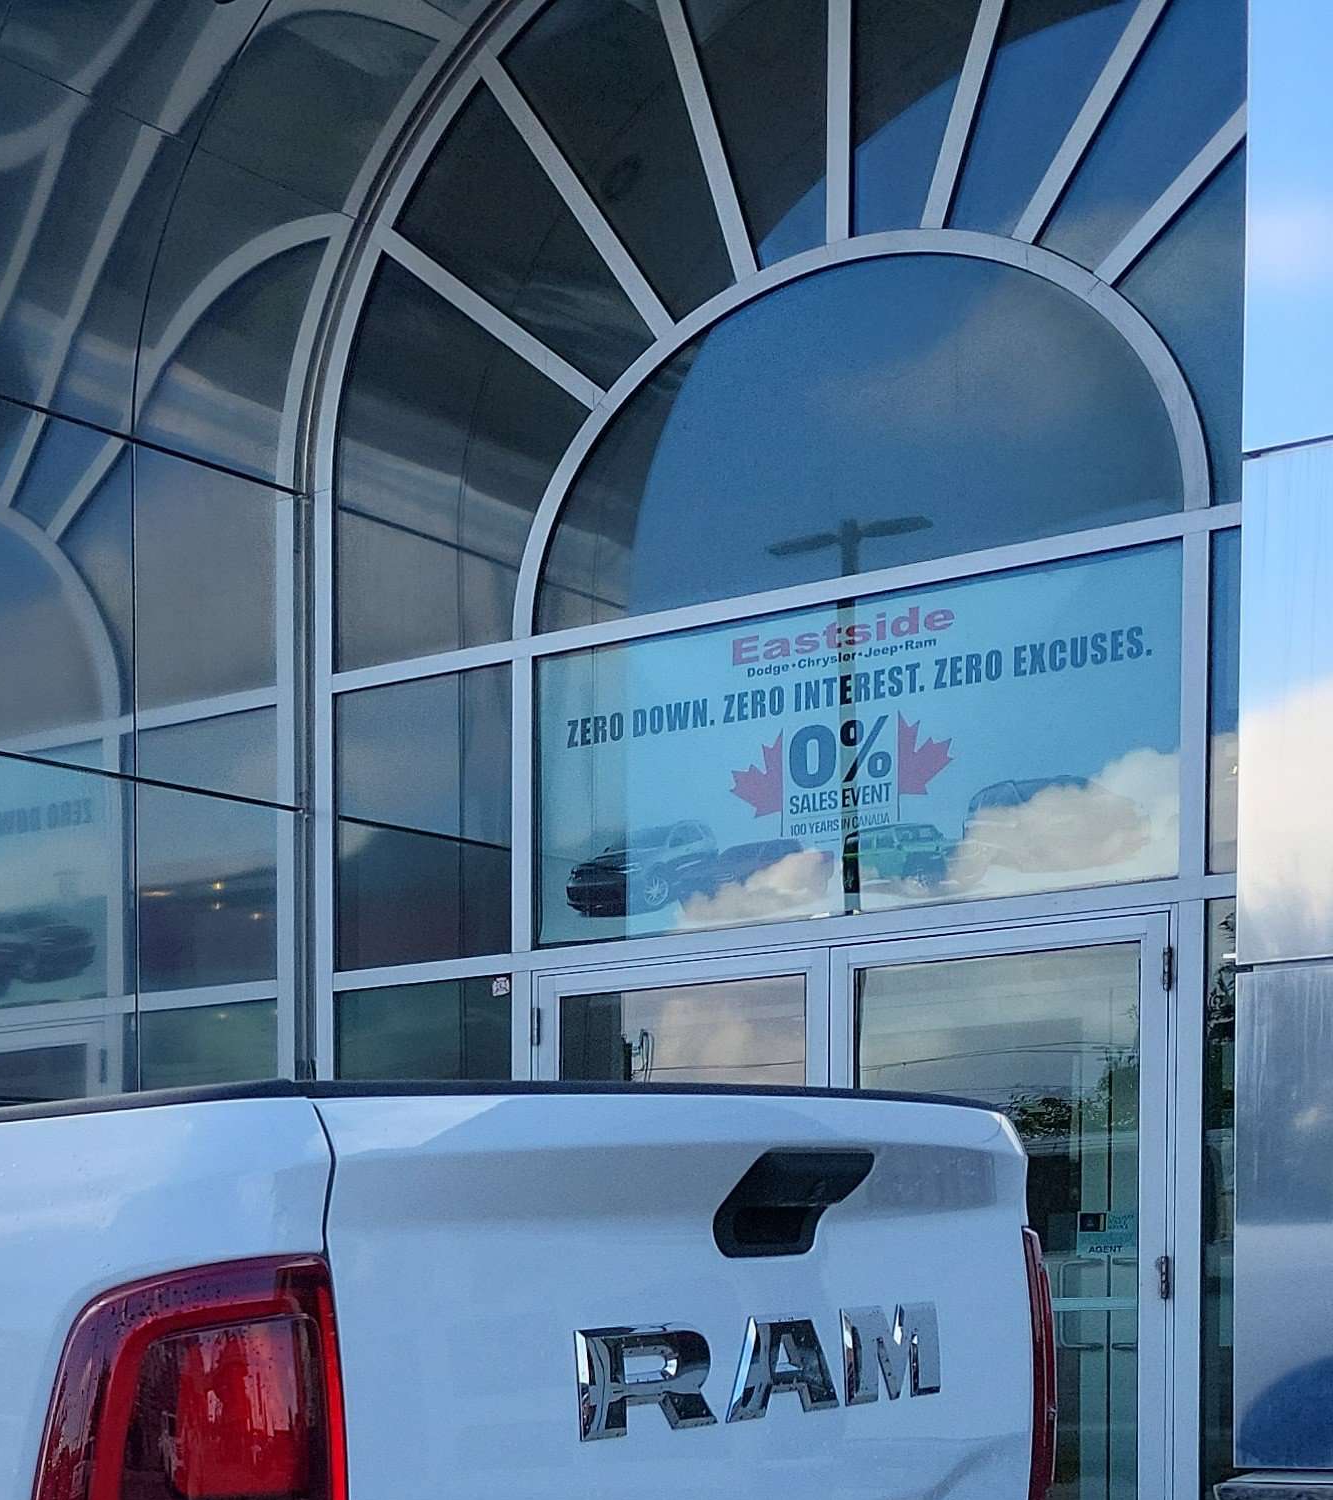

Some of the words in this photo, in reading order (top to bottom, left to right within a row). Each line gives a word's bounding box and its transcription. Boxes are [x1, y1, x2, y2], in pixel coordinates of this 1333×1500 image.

[732, 606, 956, 666] Eastside
[566, 711, 624, 749] ZERO
[633, 697, 716, 738] DOWN.
[723, 681, 784, 724] ZERO
[794, 661, 925, 713] INTEREST.
[933, 649, 1003, 690] ZERO
[1013, 625, 1153, 678] EXCUSES.
[789, 714, 893, 789] 0%
[789, 790, 838, 815] SALES
[841, 782, 893, 808] EVENT
[790, 824, 807, 837] 100
[809, 818, 840, 835] YEARS
[841, 816, 851, 830] IN
[851, 812, 891, 829] CANADA
[1088, 1245, 1123, 1254] AGENT
[573, 1302, 942, 1443] RAM
